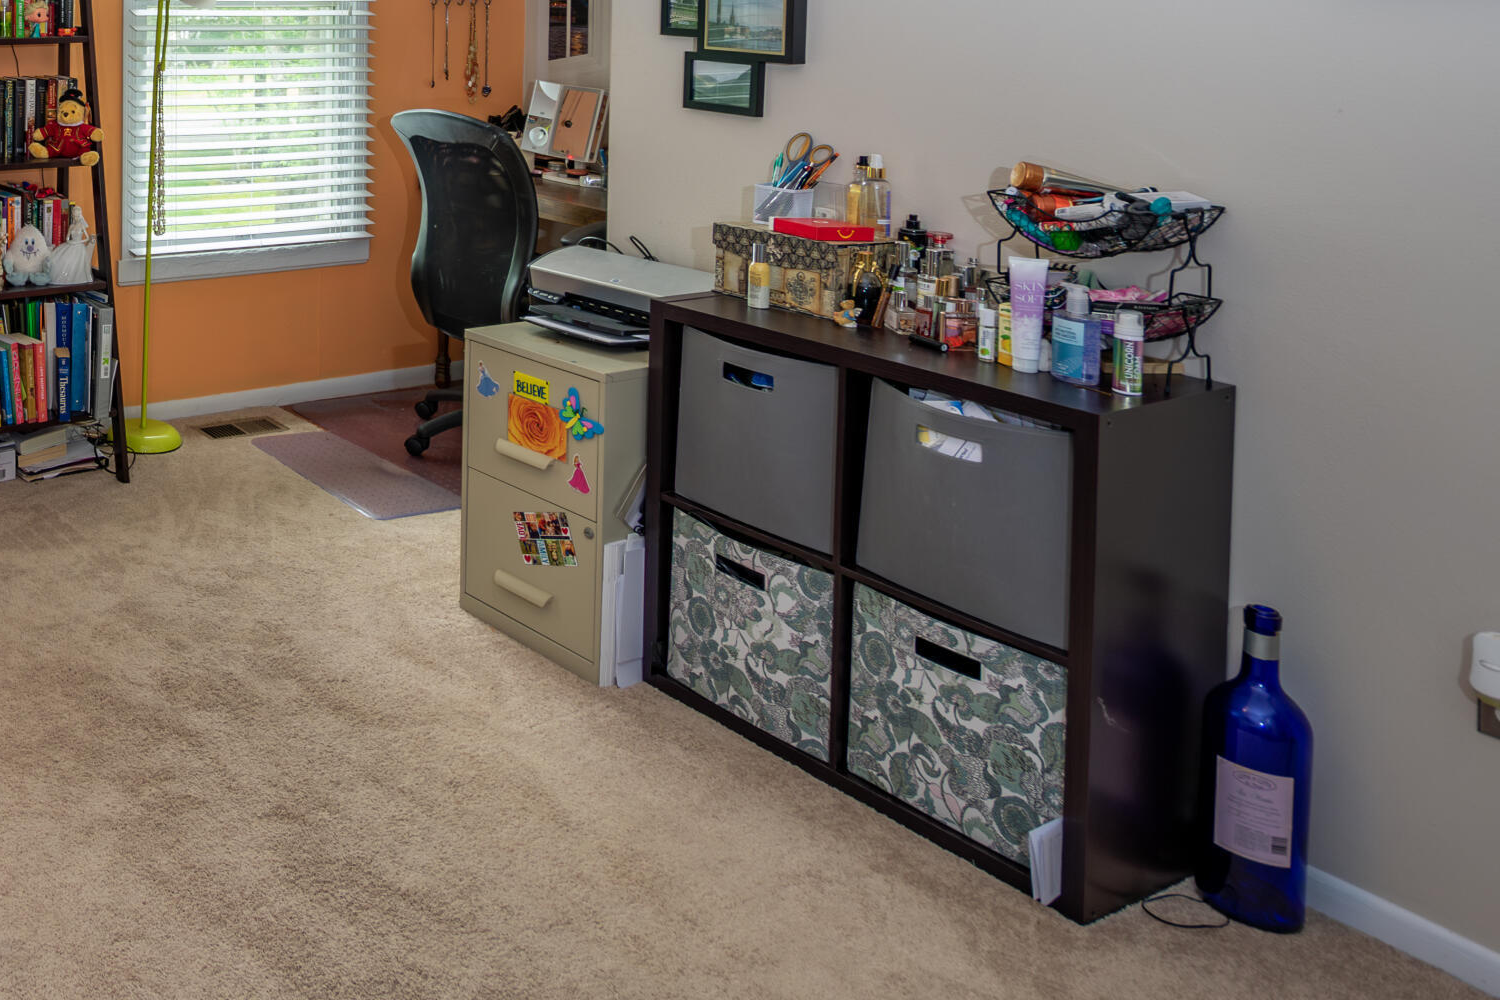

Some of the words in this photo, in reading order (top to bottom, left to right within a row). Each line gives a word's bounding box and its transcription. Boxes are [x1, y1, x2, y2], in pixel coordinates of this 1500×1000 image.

[1014, 282, 1045, 291] SKIN
[1124, 341, 1135, 379] UNICORN
[59, 376, 69, 414] Thesaurus
[516, 380, 547, 400] BELIEVE
[516, 523, 526, 540] LOVE
